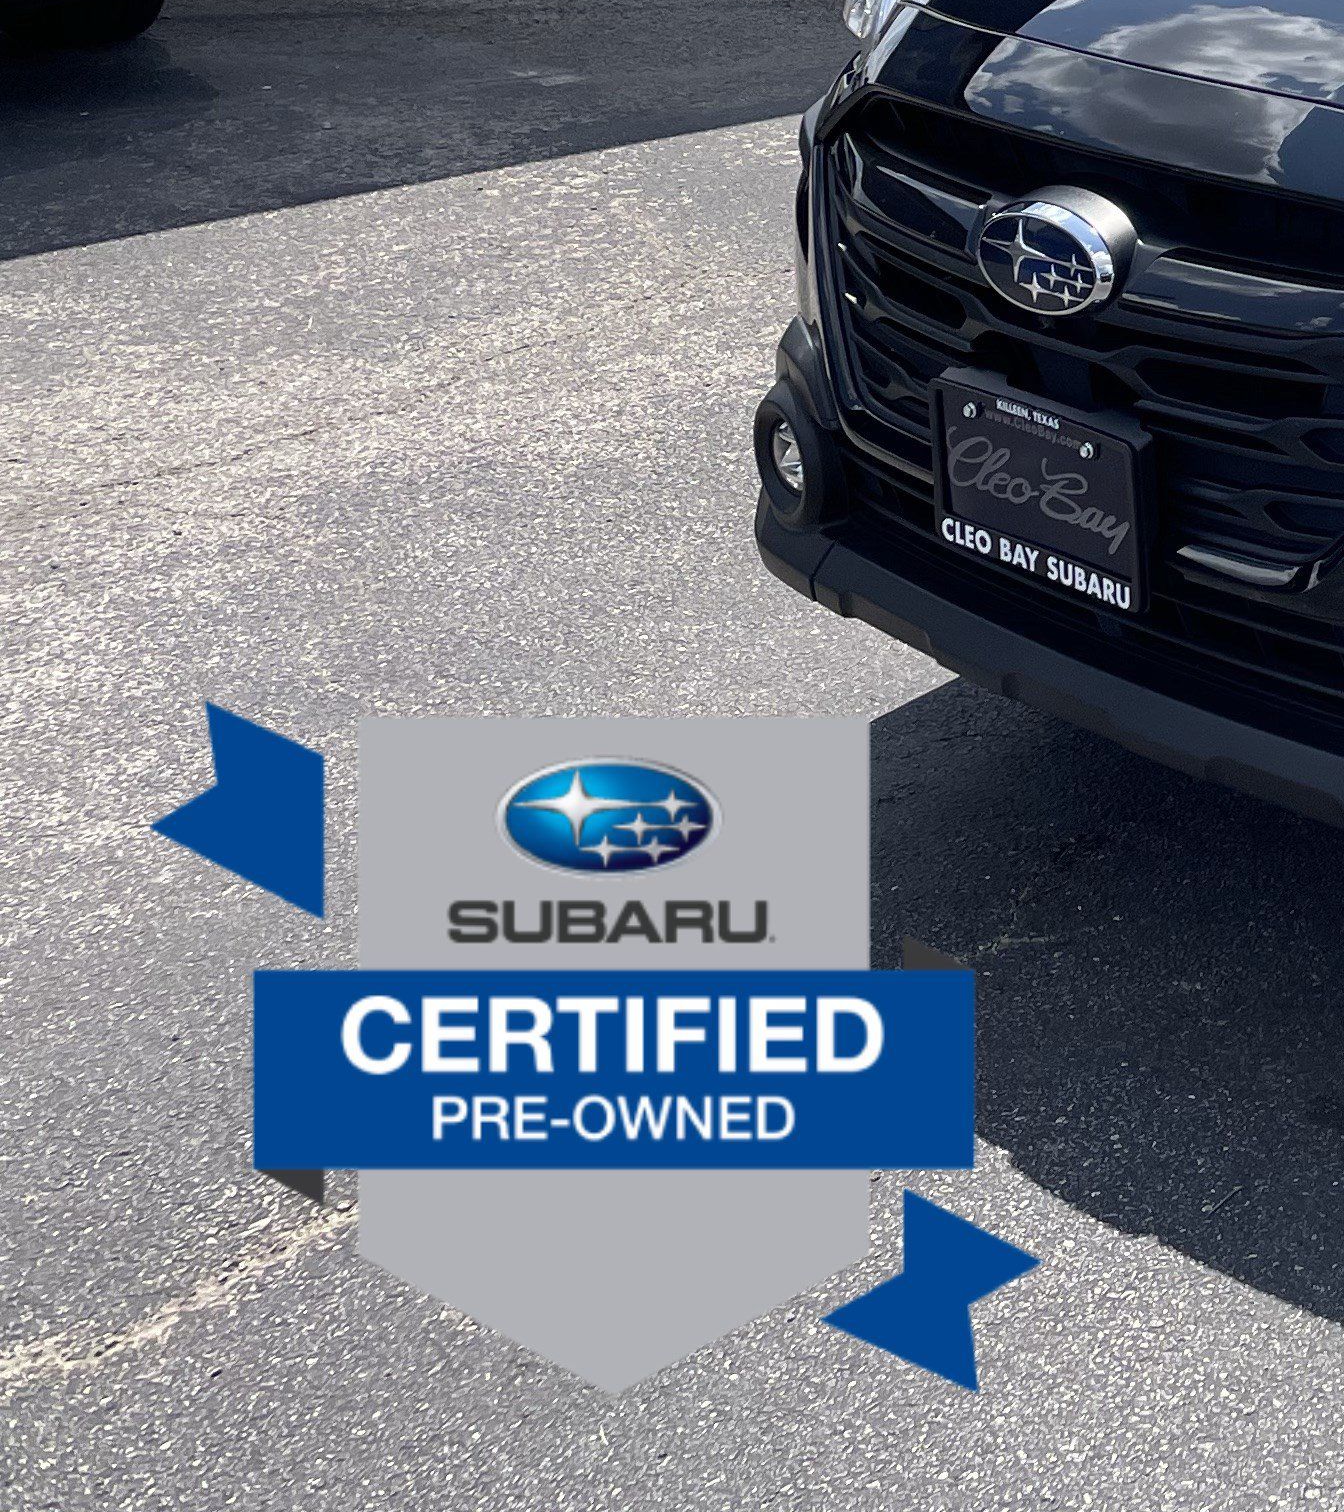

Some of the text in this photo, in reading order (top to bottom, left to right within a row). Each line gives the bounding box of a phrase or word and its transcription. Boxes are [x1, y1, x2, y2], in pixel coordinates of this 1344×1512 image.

[1033, 410, 1060, 429] TEXAS
[946, 425, 1131, 555] Cleo Bay
[941, 517, 1131, 610] CLEO BAY SUBARU
